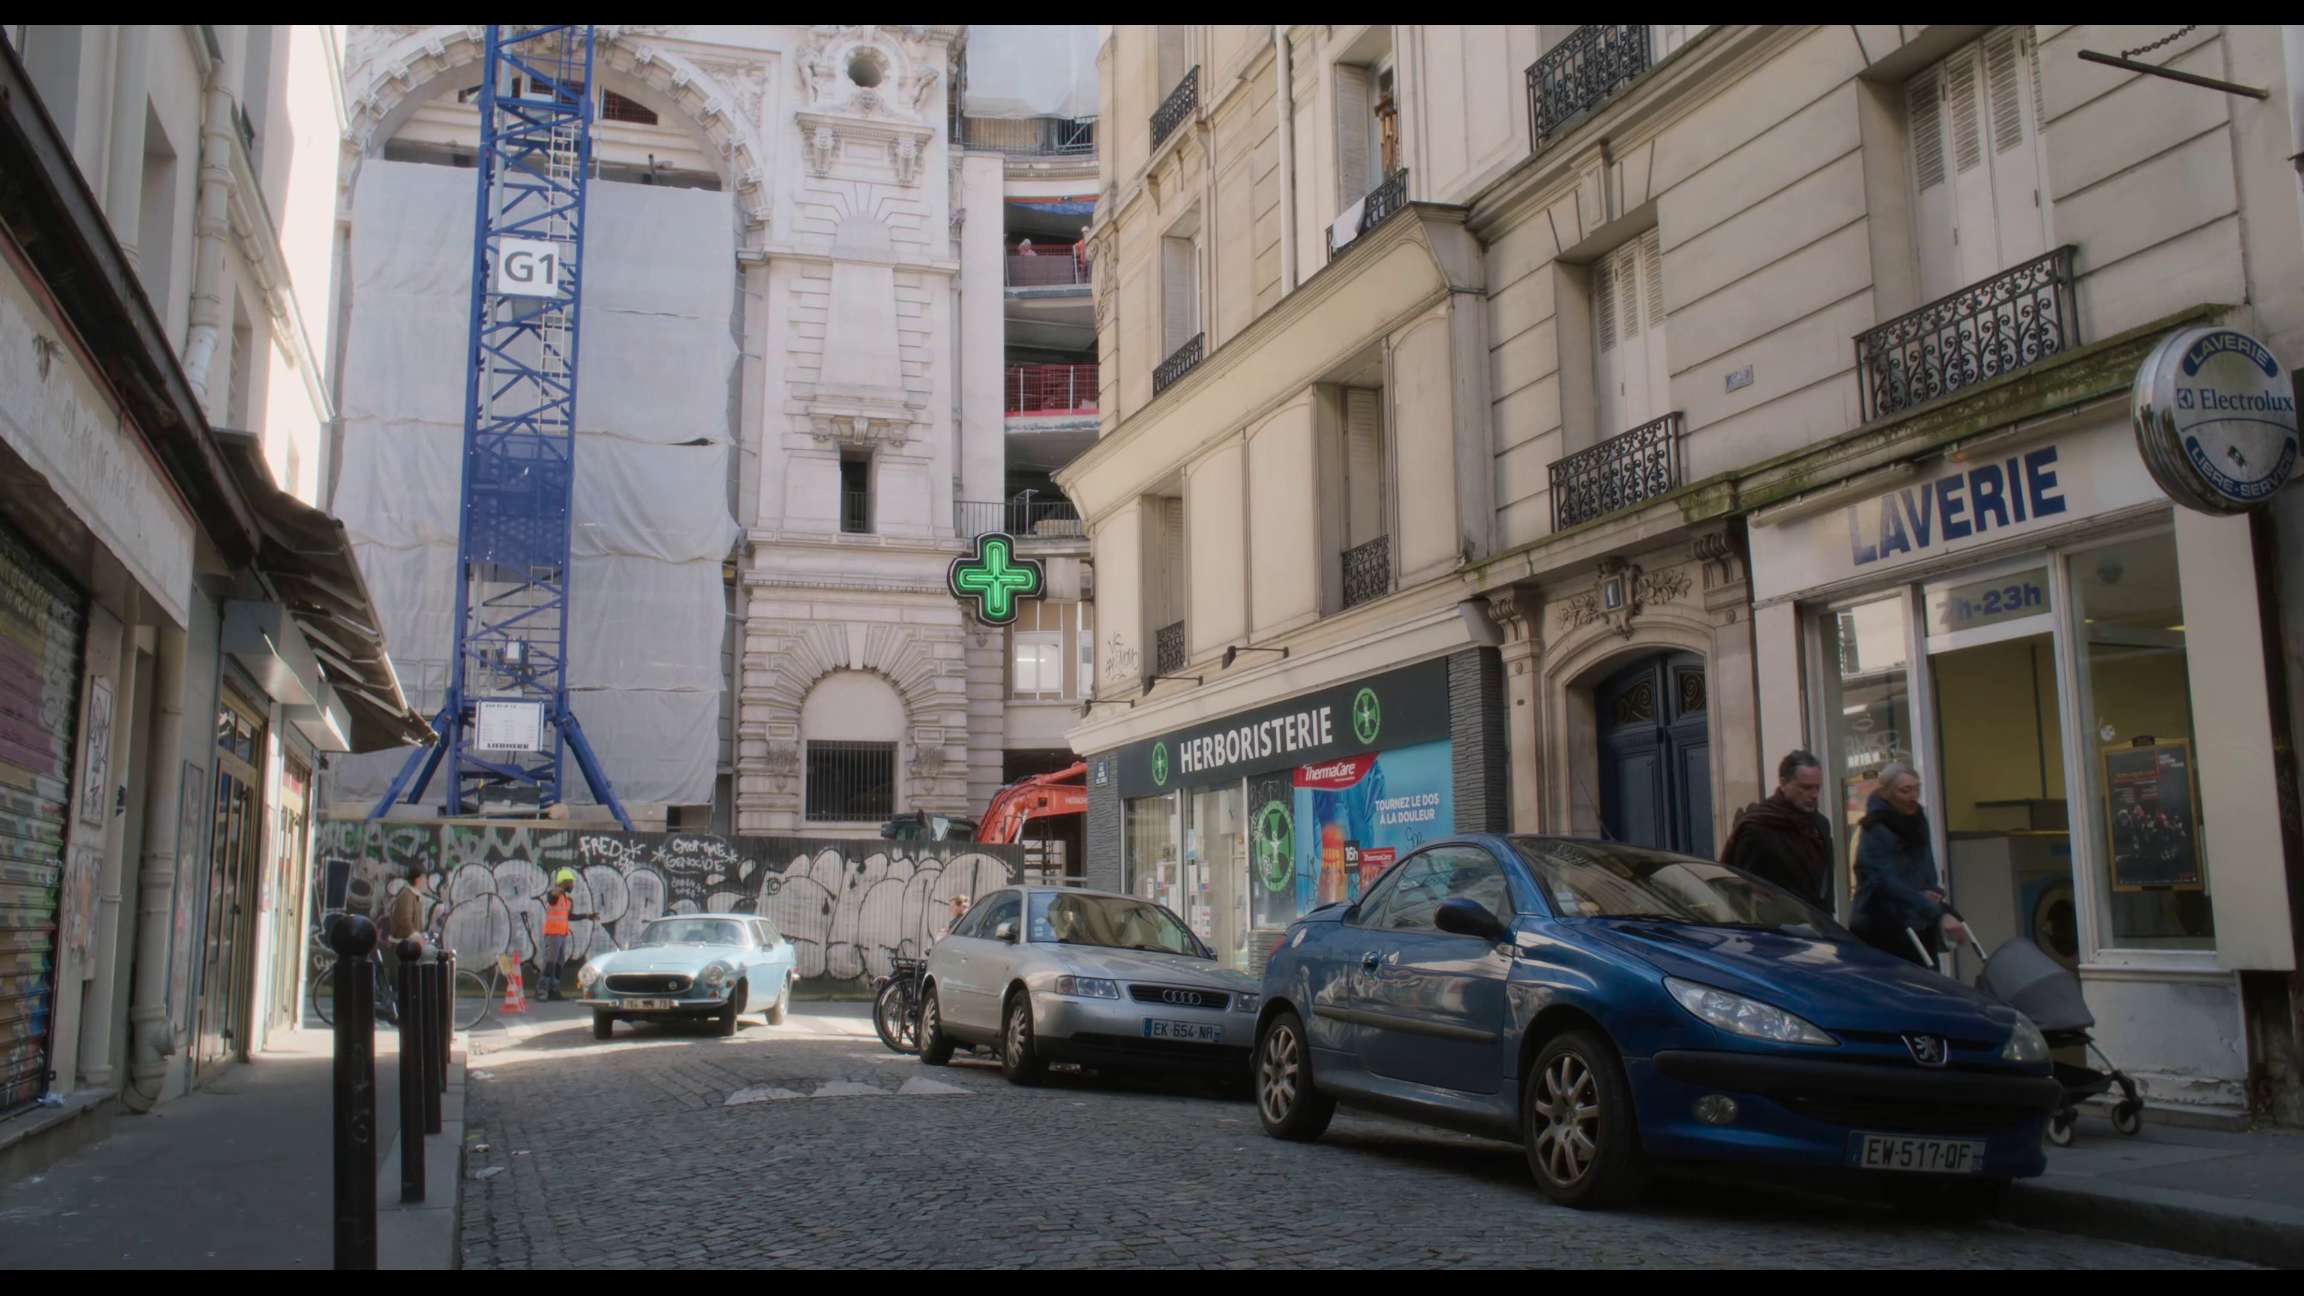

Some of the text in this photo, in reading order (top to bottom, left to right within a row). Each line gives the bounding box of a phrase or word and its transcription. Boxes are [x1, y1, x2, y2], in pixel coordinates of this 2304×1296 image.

[504, 251, 554, 285] G1
[2189, 334, 2270, 367] LAVERIE
[2199, 389, 2294, 411] Electrolux
[2190, 448, 2295, 496] LIBRE-SERVICE
[1848, 445, 2066, 566] LAVERIE
[1180, 706, 1333, 774] HERBORISTERIE
[1304, 762, 1356, 781] ThermaCare
[1376, 792, 1440, 811] TOURNEZ LE DOS
[1387, 811, 1398, 825] LA
[1399, 808, 1436, 823] DOULEUR
